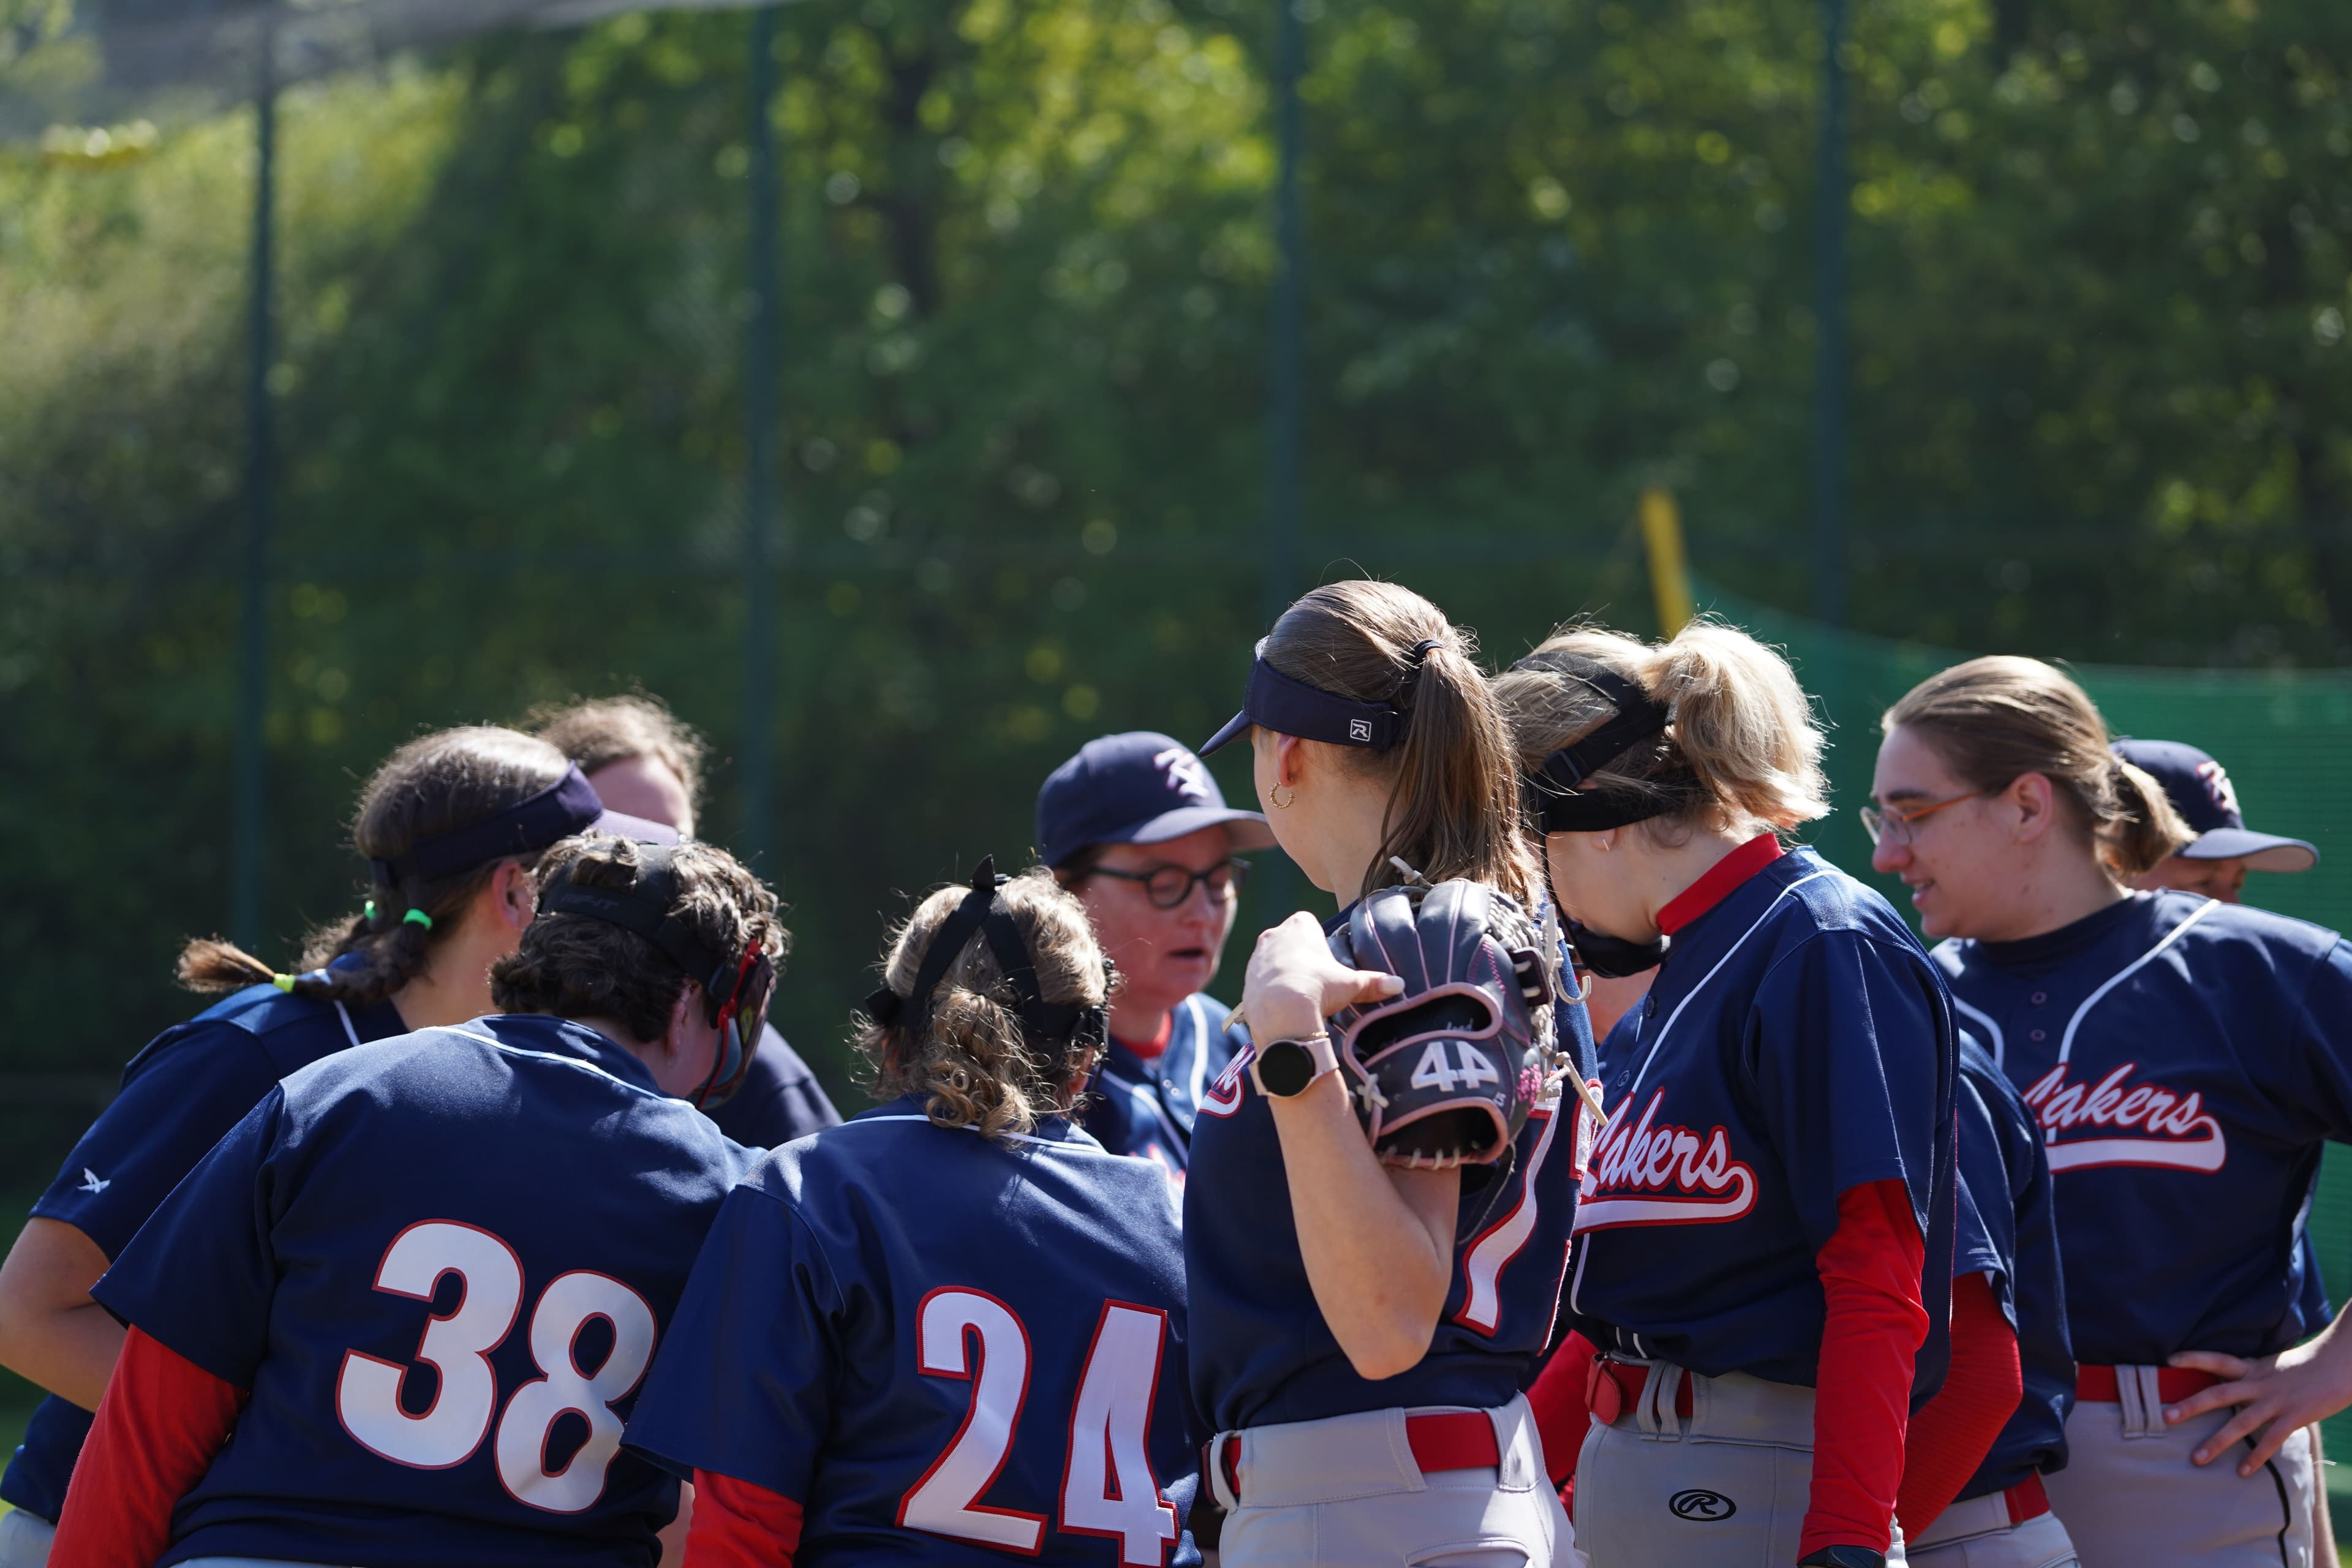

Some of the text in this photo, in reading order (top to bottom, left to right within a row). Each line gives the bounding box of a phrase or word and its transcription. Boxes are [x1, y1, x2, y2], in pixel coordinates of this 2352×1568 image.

[1351, 722, 1369, 738] R
[1410, 1040, 1499, 1091] 44
[335, 1218, 658, 1515] 38
[895, 1286, 1179, 1567] 24
